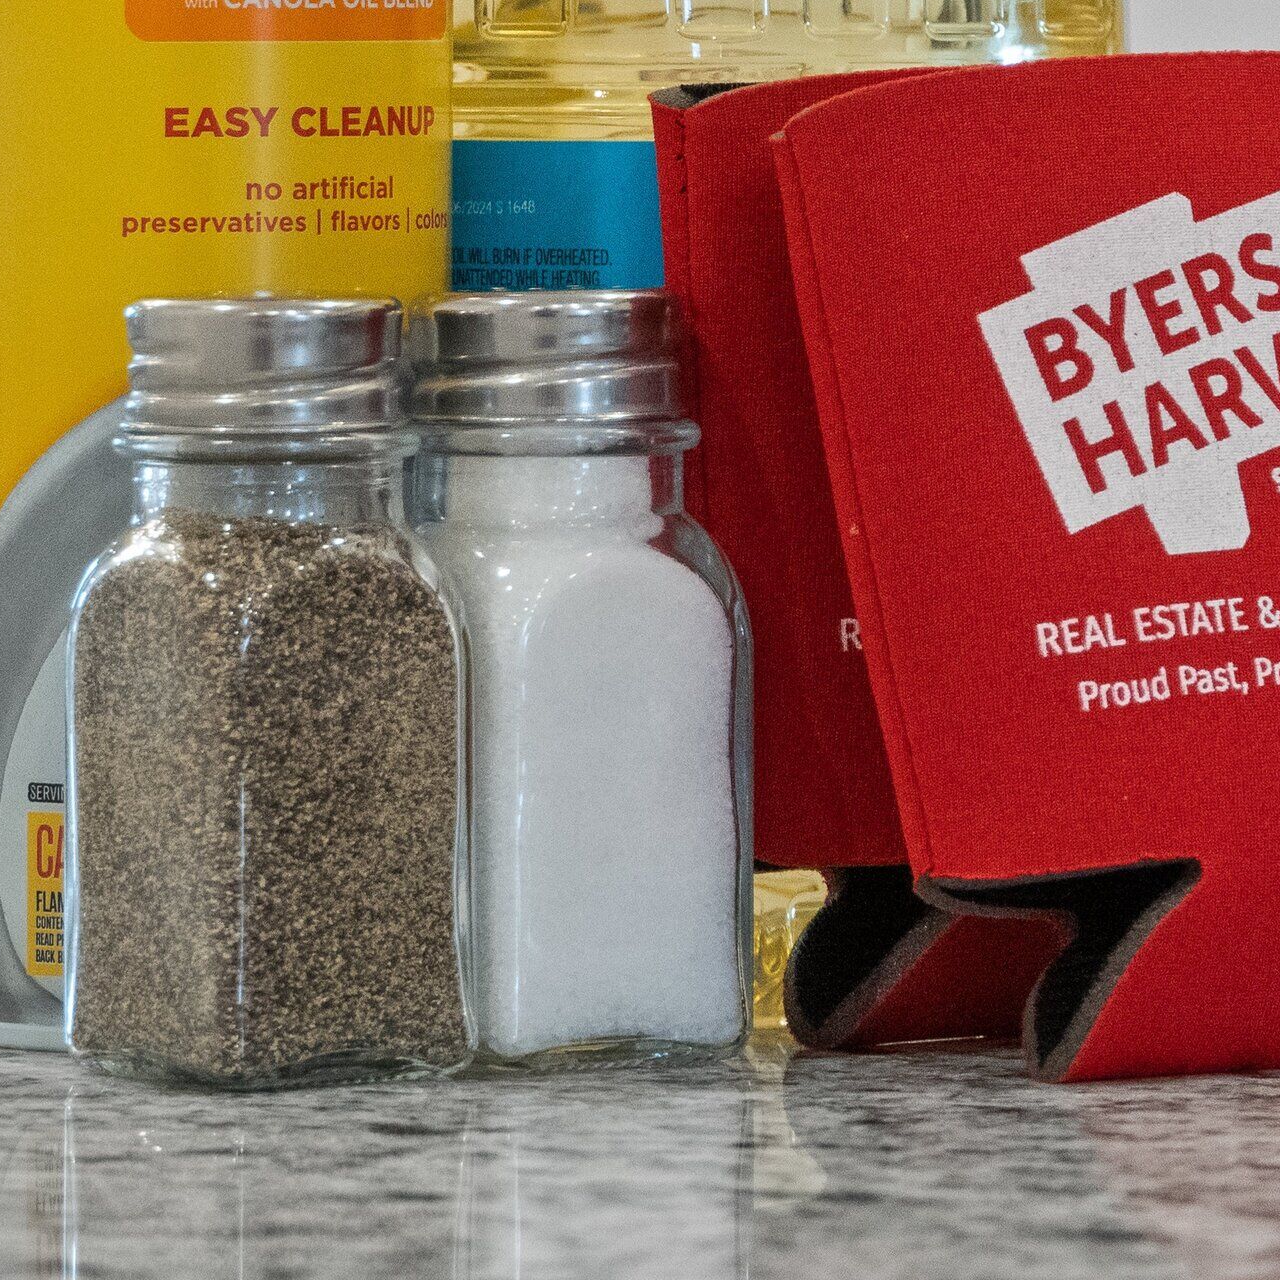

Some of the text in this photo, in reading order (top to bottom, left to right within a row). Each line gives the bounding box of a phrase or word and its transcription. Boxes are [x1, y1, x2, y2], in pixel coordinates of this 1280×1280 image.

[164, 105, 435, 138] EASY CLEANUP
[245, 175, 394, 201] no artificial
[508, 200, 536, 214] 1648
[122, 212, 307, 238] preservatives
[331, 209, 400, 232] flavors
[492, 247, 520, 265] BURN
[523, 247, 532, 265] IF
[536, 248, 612, 266] OVERHEATED.
[516, 269, 548, 287] WHILE
[1036, 613, 1127, 658] REAL
[1133, 596, 1249, 643] ESTATE
[1078, 667, 1171, 712] Proud
[1177, 662, 1250, 697] Past,
[36, 932, 54, 946] READ
[36, 949, 56, 963] BACK
